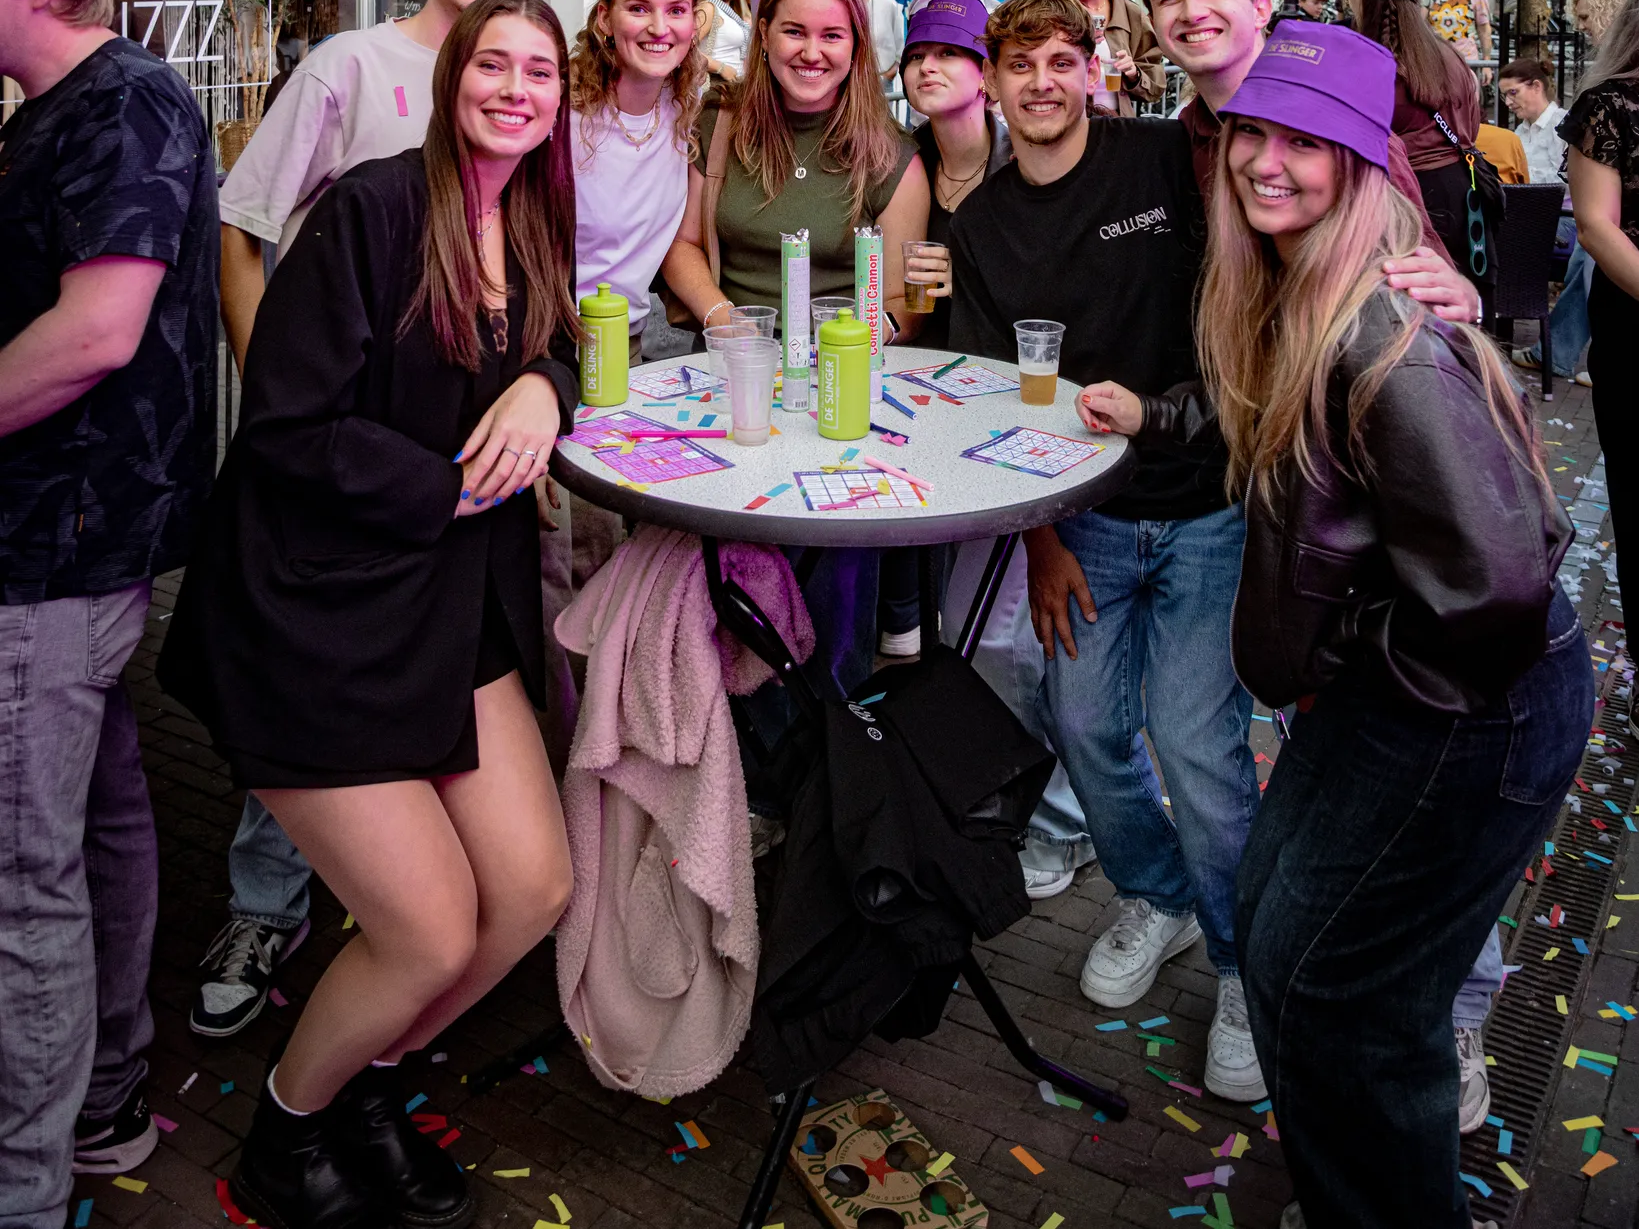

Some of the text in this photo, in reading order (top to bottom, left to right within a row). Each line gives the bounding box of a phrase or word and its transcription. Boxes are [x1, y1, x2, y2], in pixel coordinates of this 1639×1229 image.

[1099, 206, 1167, 240] COLLUSION
[867, 254, 878, 300] Cannon
[587, 375, 597, 390] DE
[824, 360, 835, 421] DE SLINGER
